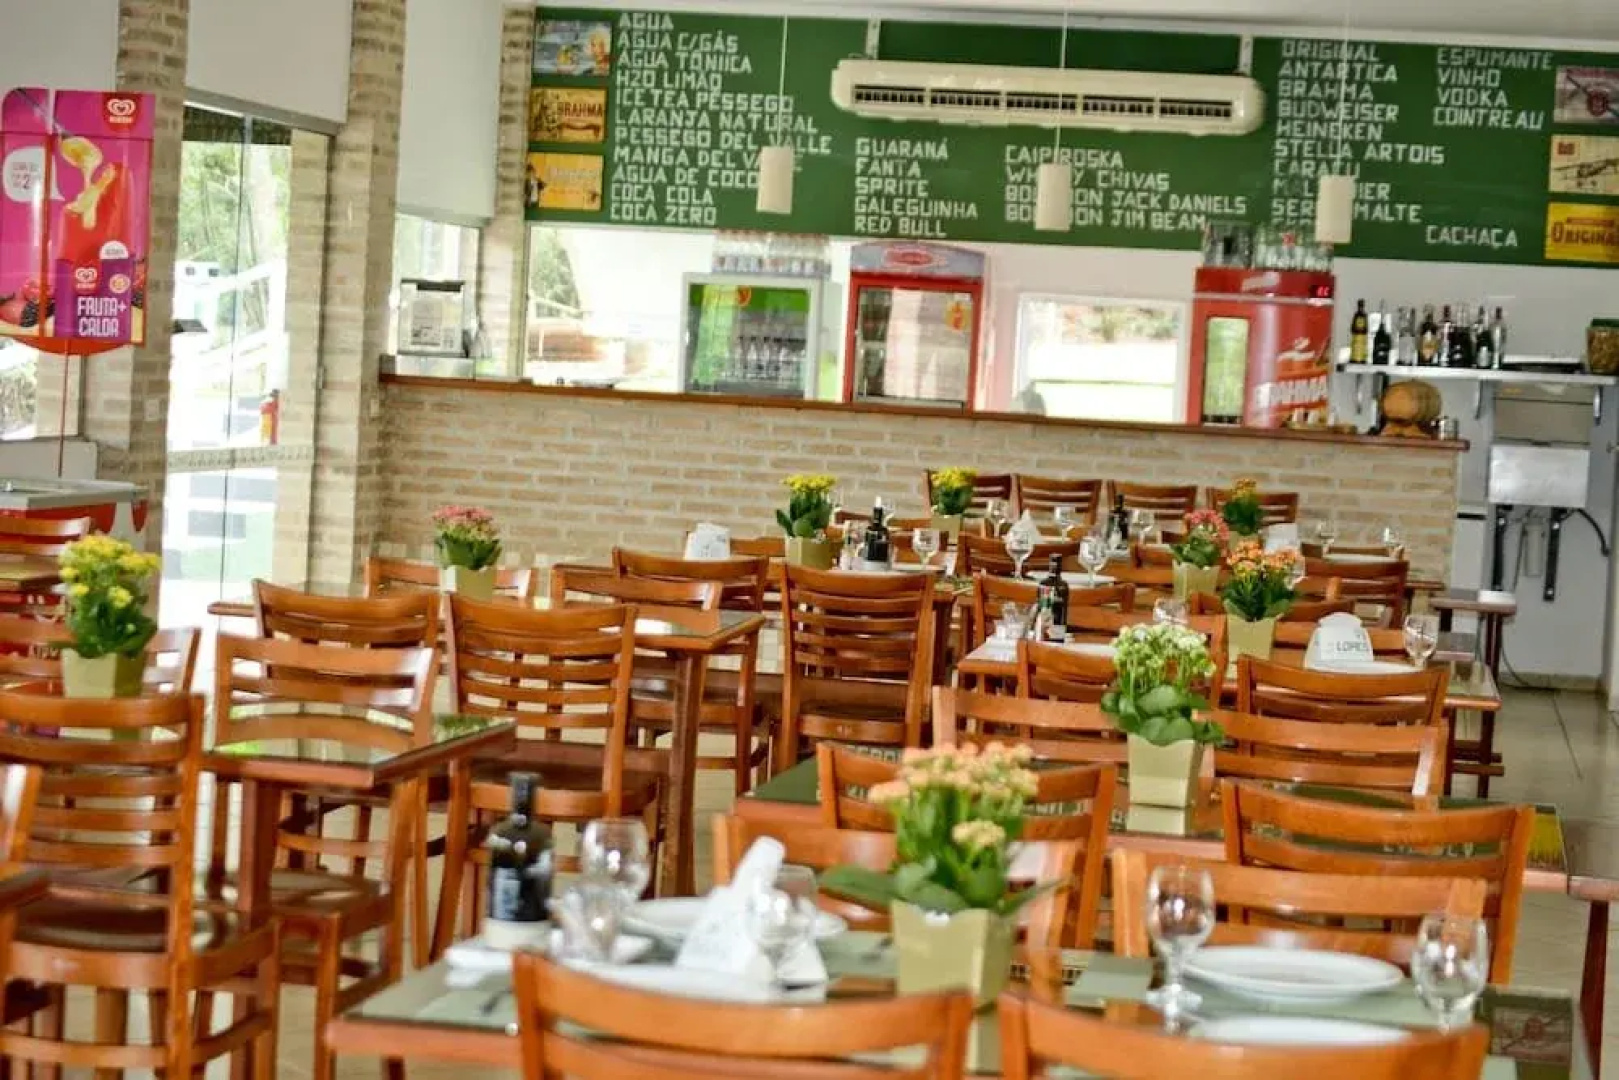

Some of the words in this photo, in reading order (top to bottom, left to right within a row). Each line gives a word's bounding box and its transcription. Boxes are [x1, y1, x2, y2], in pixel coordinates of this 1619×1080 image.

[1281, 39, 1379, 61] ORIGINAL
[1437, 47, 1553, 70] ESPUMANTE
[615, 69, 656, 88] H2O
[1438, 68, 1501, 87] VINHO
[615, 88, 645, 106] ICE
[651, 88, 689, 108] TEA
[1279, 79, 1374, 101] BRAHMA
[1438, 87, 1508, 107] VODKA
[615, 108, 711, 128] LARANJA
[719, 111, 818, 133] NATURAL
[1278, 99, 1399, 123] BUDWEISER
[1433, 107, 1544, 130] COINTREAU
[720, 131, 758, 149] DEL
[1277, 119, 1383, 141] HEINEKEN
[614, 146, 689, 166] MANGA
[698, 150, 736, 168] DEL
[855, 137, 949, 160] GUARANÁ
[1005, 145, 1124, 169] CAIPROSKA
[1274, 138, 1352, 159] STELLA
[1364, 142, 1445, 165] ARTOIS
[675, 168, 699, 185] DE
[708, 170, 759, 189] COCO
[855, 157, 921, 178] FANTA
[1006, 164, 1084, 186] WHY
[1097, 170, 1171, 191] CHIVAS
[611, 182, 656, 202] COCA
[667, 186, 714, 205] COLA
[855, 176, 929, 197] SPRITE
[854, 195, 978, 218] GALEGUINHA
[1005, 184, 1104, 206] BOON
[1110, 190, 1162, 209] JACK
[1169, 194, 1247, 215] DANIELS
[610, 203, 658, 221] COCA
[665, 206, 717, 226] ZERO
[1005, 205, 1104, 226] BOON
[1110, 209, 1145, 229] JIM
[1151, 212, 1206, 231] BEAM
[854, 215, 892, 234] RED
[898, 216, 947, 238] BULL
[1426, 225, 1518, 249] CACHAÇA
[78, 317, 119, 338] CALDA
